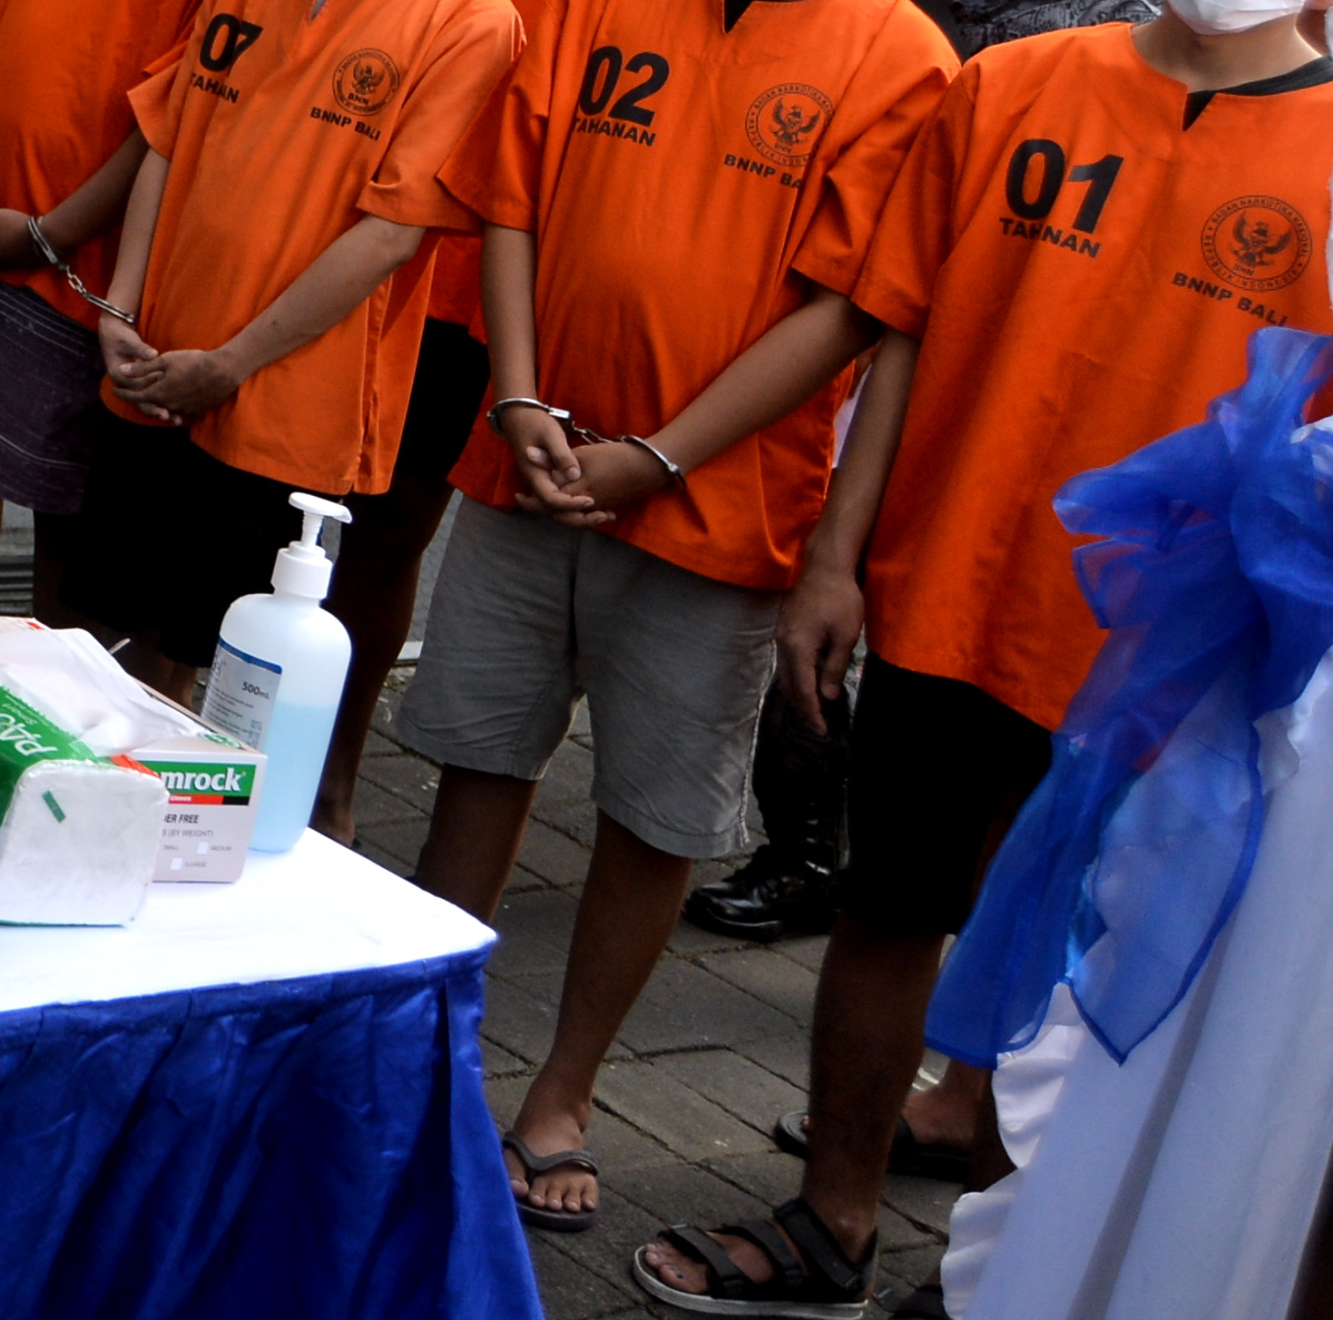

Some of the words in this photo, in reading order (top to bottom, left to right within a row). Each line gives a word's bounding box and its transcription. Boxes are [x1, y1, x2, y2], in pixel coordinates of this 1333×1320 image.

[199, 12, 264, 78] 07
[578, 45, 670, 128] 02
[310, 106, 353, 128] BNNP
[354, 120, 382, 142] BALI
[723, 152, 778, 179] BNNP
[779, 172, 802, 190] BA
[1005, 138, 1124, 236] 01
[1172, 271, 1233, 301] BNNP
[1236, 296, 1289, 327] BALI
[160, 767, 241, 792] mrock
[178, 814, 200, 825] FREE
